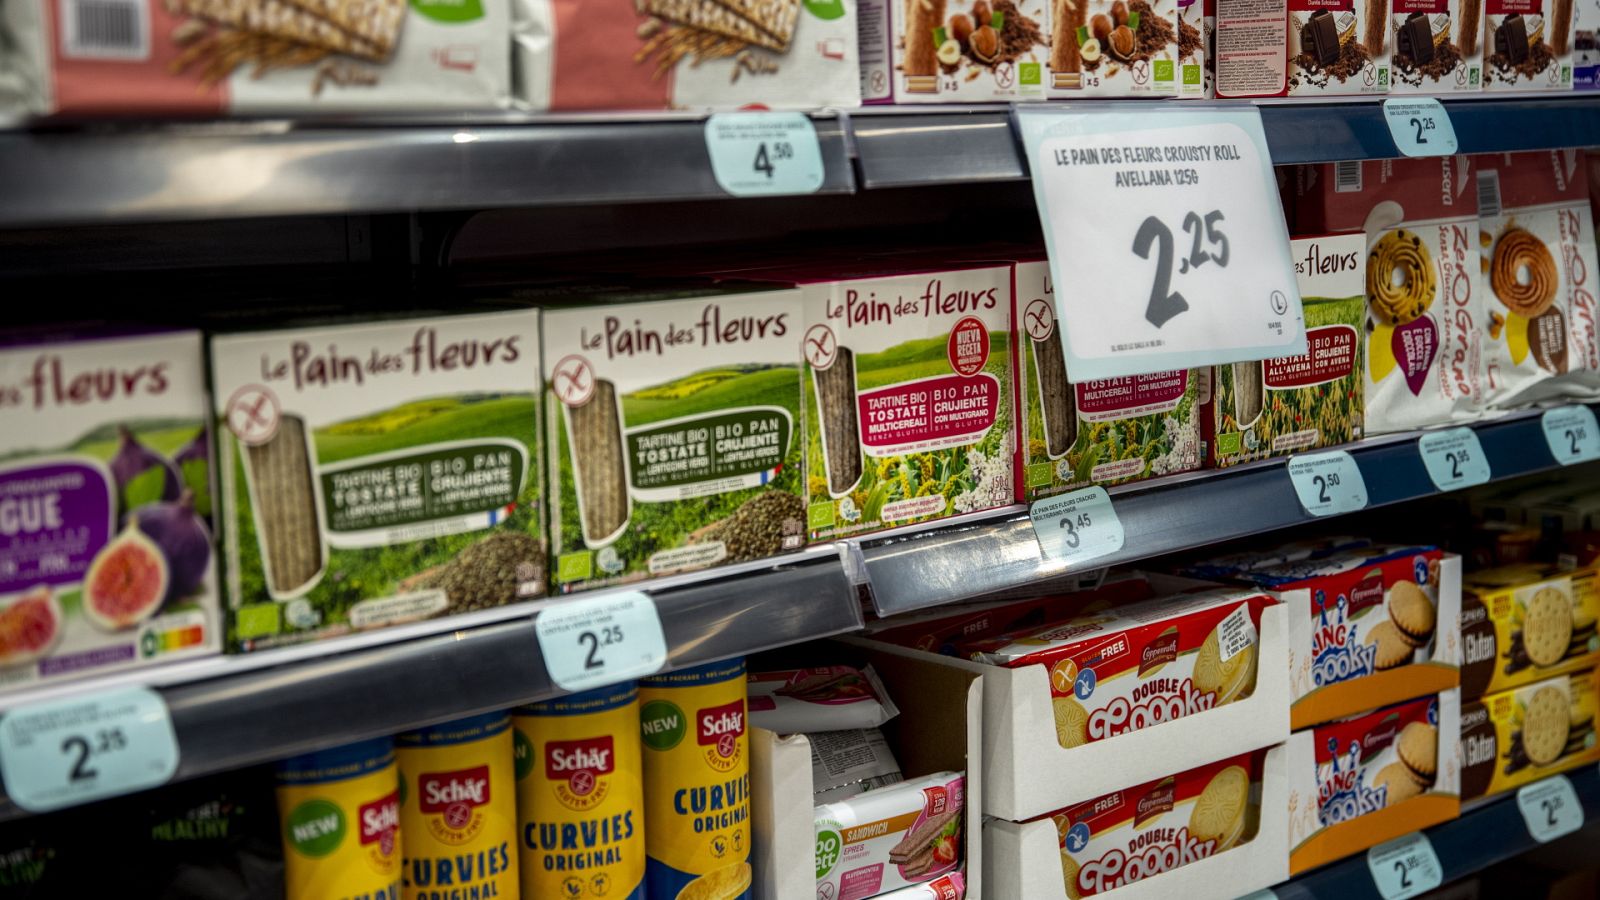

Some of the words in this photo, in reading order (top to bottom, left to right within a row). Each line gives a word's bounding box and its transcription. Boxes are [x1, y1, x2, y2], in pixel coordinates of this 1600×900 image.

[1410, 117, 1436, 144] 2,25
[1054, 148, 1069, 165] LE
[1072, 148, 1100, 165] PAIN
[1102, 147, 1122, 164] DES
[1124, 146, 1163, 163] FLEURS
[1165, 145, 1212, 162] CROUSTY
[1214, 144, 1241, 160] ROLL
[1115, 169, 1172, 187] AVELLANA
[1173, 169, 1199, 185] 125G
[1131, 209, 1230, 329] 2,25
[1305, 243, 1357, 276] fleurs
[827, 299, 843, 319] Le
[846, 290, 892, 328] Pain
[893, 296, 918, 317] des
[919, 279, 998, 318] fleurs
[581, 326, 603, 352] Le
[604, 316, 663, 359] Pain
[664, 323, 694, 345] des
[695, 304, 789, 347] fleurs
[1315, 337, 1331, 348] BIO
[1334, 334, 1350, 344] PAN
[261, 352, 289, 381] Le
[290, 340, 364, 391] Pain
[366, 348, 401, 375] des
[407, 326, 521, 375] fleurs
[1315, 345, 1350, 359] CRUJIENTE
[1315, 359, 1328, 368] CON
[1330, 355, 1350, 366] AVENA
[1269, 363, 1310, 376] ALL'AVENA
[30, 355, 171, 411] fleurs
[934, 387, 957, 401] BIO
[963, 383, 988, 396] PAN
[1084, 386, 1132, 401] MULTICEREALI
[1137, 383, 1149, 392] CON
[868, 394, 908, 410] TARTINE
[909, 391, 927, 405] BIO
[934, 396, 989, 413] CRUJIENTE
[868, 404, 926, 423] TOSTATE
[934, 415, 949, 424] CON
[949, 409, 989, 421] MULTIGRANO
[715, 422, 743, 440] BIO
[750, 417, 779, 434] PAN
[868, 417, 927, 434] MULTICEREALI
[636, 431, 686, 450] TARTINE
[687, 427, 709, 443] BIO
[715, 432, 780, 453] CRUJIENTE
[636, 443, 707, 466] TOSTATE
[1313, 473, 1340, 503] 2,50
[1032, 508, 1038, 516] LE
[1038, 505, 1048, 514] PAIN
[1058, 498, 1076, 509] FLEURS
[1076, 493, 1097, 504] CRACKER
[1060, 512, 1091, 549] 3,45
[577, 625, 624, 671] 2,25
[1100, 640, 1126, 660] FREE
[1132, 677, 1179, 703] DOUBLE
[643, 714, 679, 737] NEW
[703, 711, 743, 737] Schär
[551, 746, 610, 771] Schär
[425, 777, 486, 805] Schär
[674, 773, 749, 815] CURVIE
[1094, 794, 1120, 814] FREE
[693, 803, 749, 834] ORIGINAL
[524, 810, 634, 851] CURVIES
[847, 822, 888, 842] SANDWICH
[1129, 828, 1175, 854] DOUBLE
[543, 847, 622, 872] ORIGINAL
